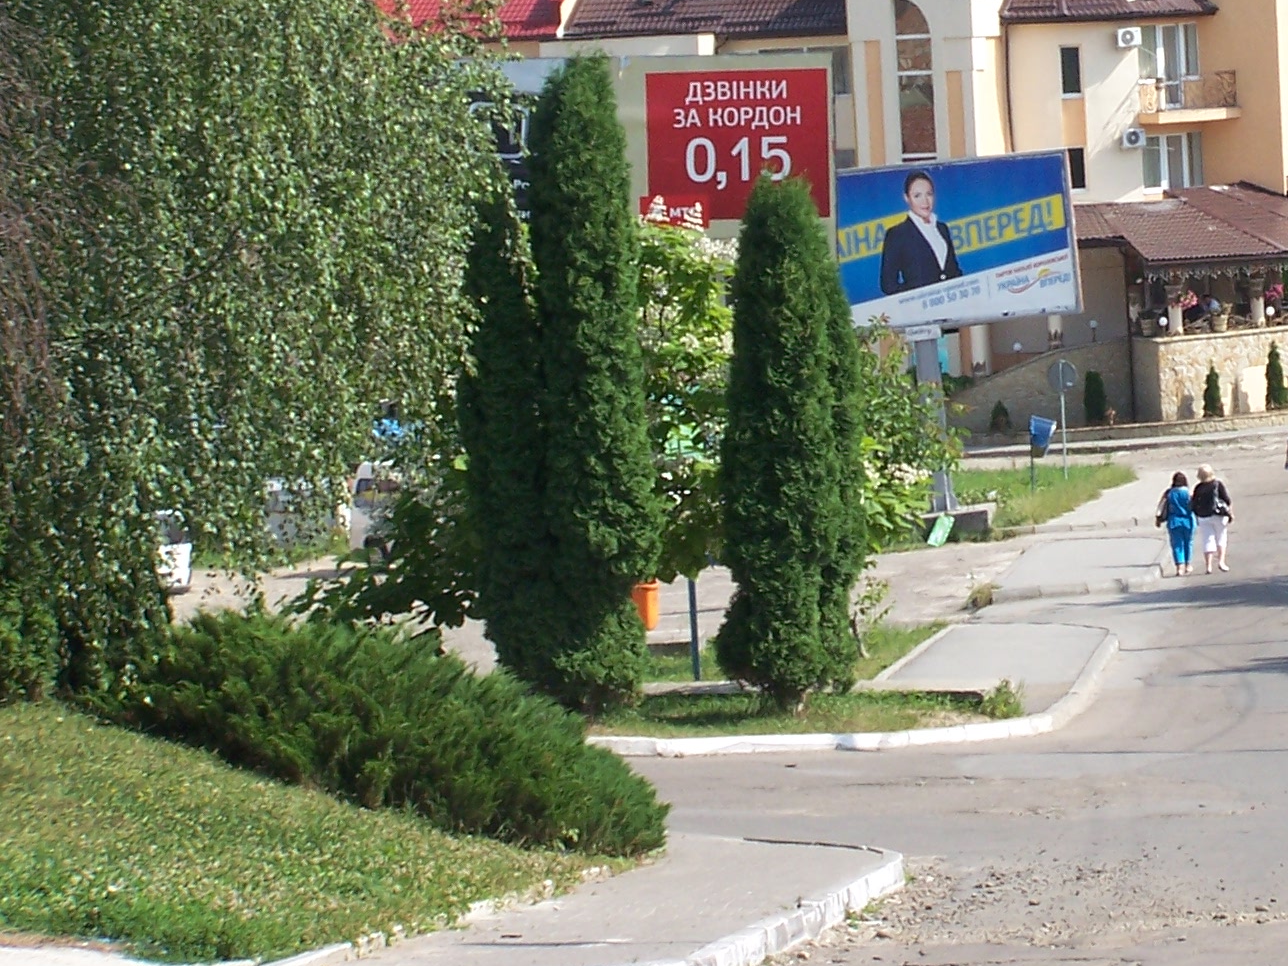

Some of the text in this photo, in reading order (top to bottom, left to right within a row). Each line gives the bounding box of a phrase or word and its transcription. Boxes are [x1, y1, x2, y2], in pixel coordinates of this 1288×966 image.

[685, 79, 788, 105] ДЗВІНКИ
[672, 105, 802, 130] ЗА КОРДОН
[685, 135, 792, 190] 0,15
[950, 201, 1054, 250] ВПЕРЕД!
